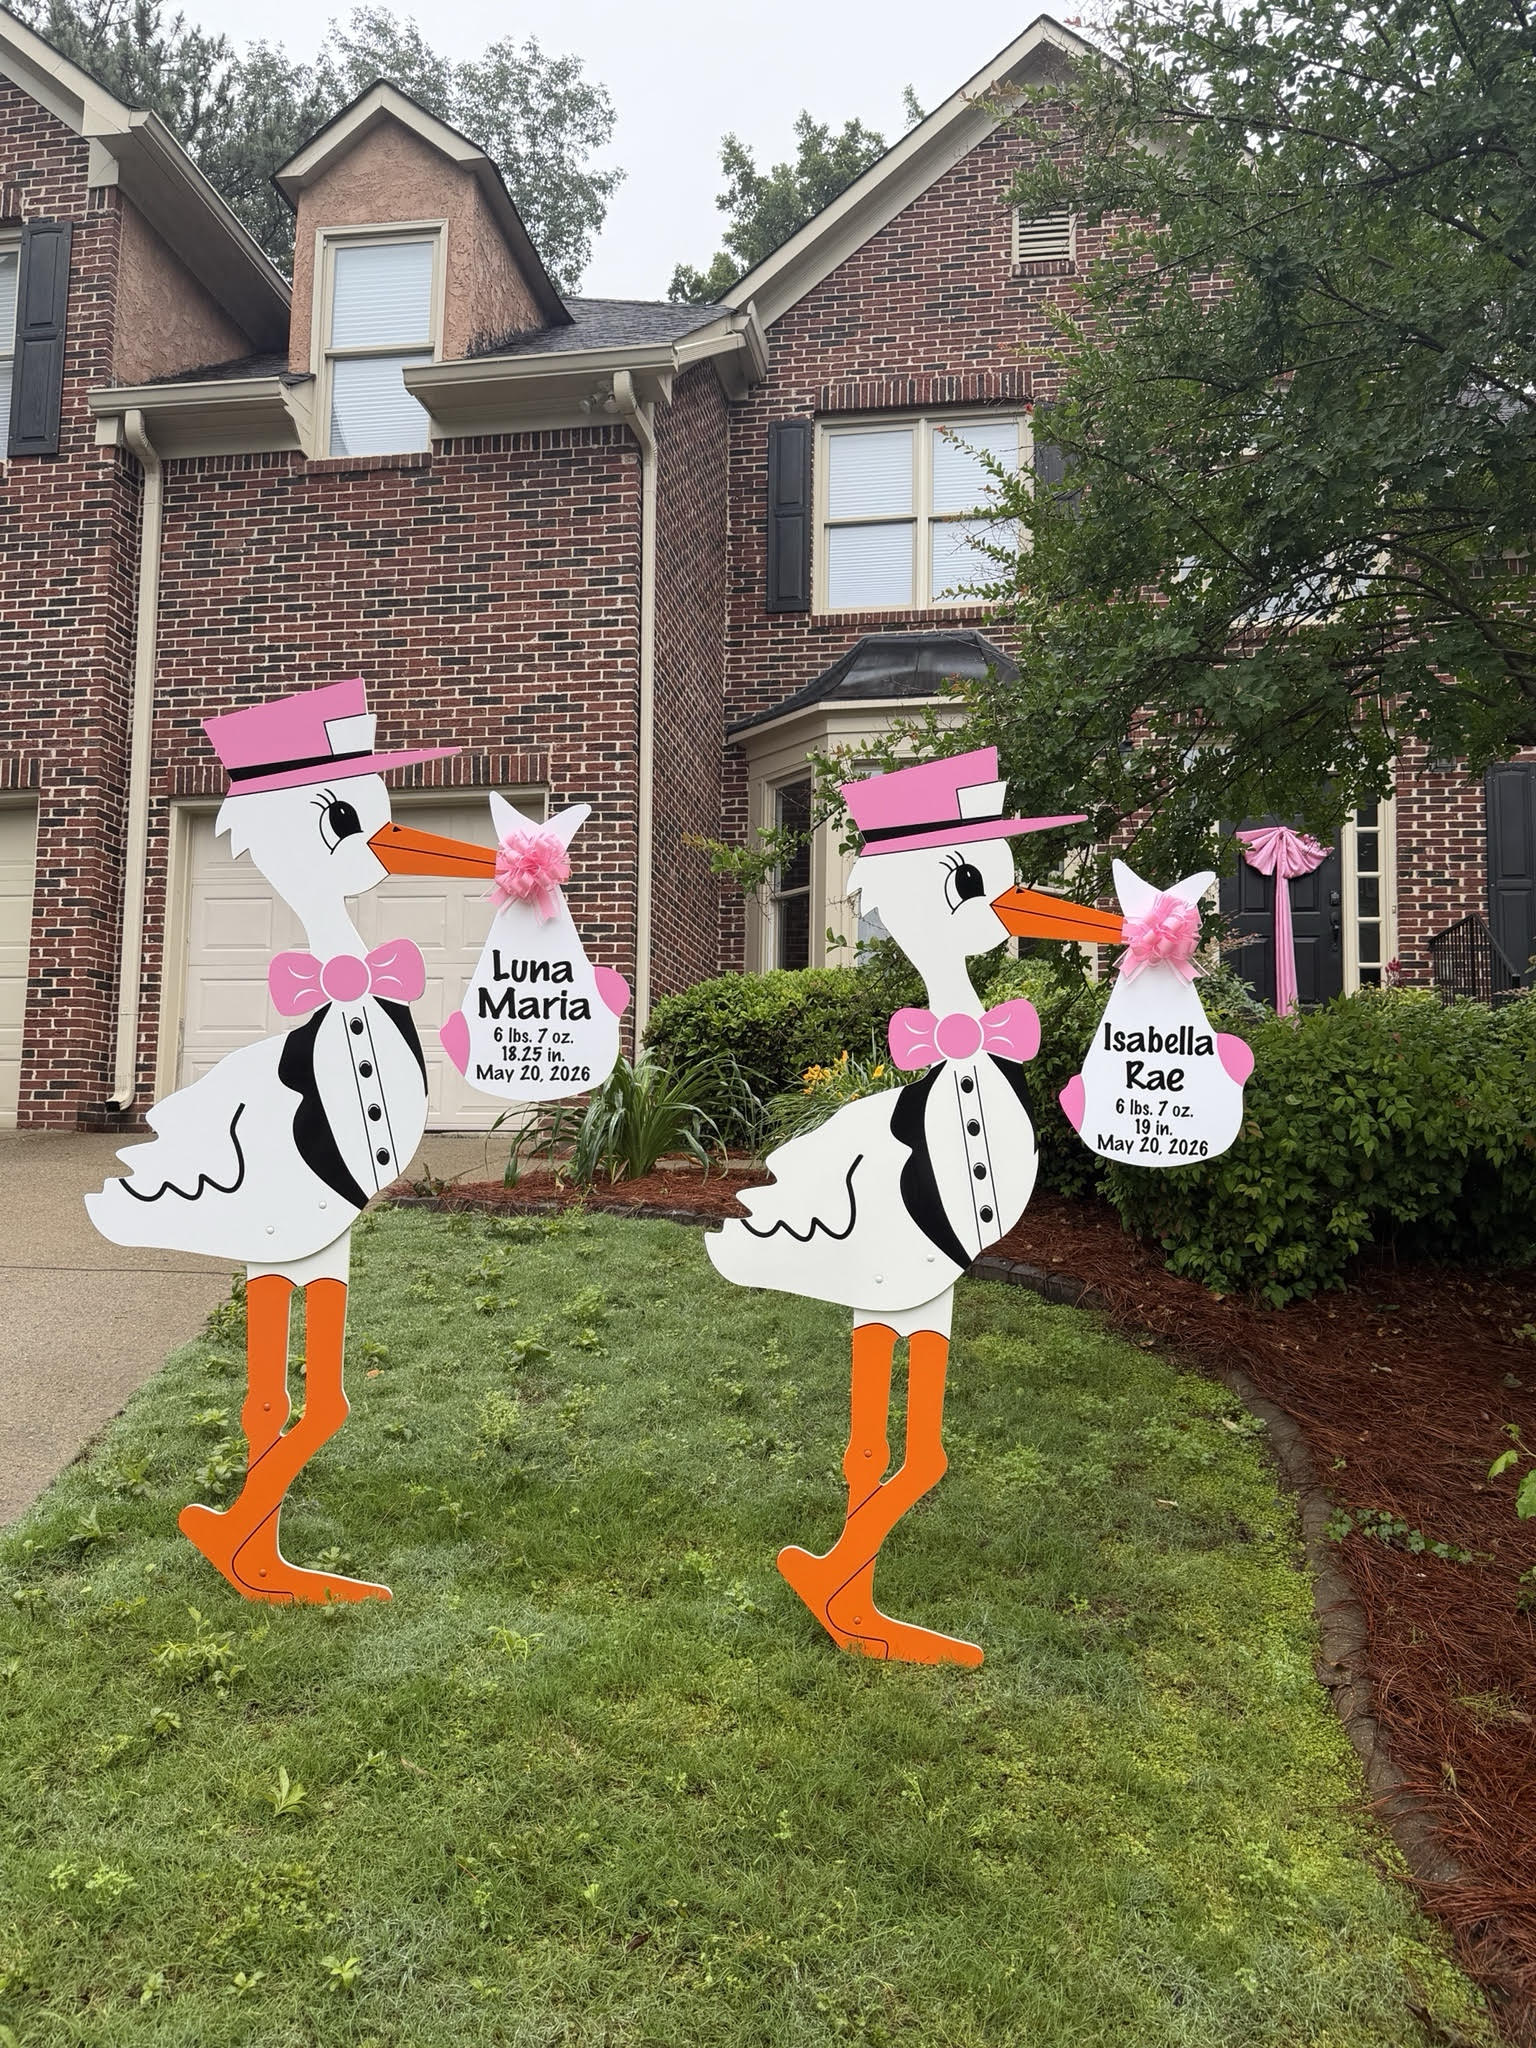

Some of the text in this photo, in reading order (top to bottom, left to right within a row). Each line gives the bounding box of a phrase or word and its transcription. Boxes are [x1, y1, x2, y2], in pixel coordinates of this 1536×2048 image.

[493, 950, 574, 983] Luna
[478, 987, 591, 1021] Maria
[494, 1027, 573, 1044] 6 lbs. 7 oz.
[1104, 1022, 1215, 1056] Isabella
[502, 1046, 564, 1062] 18.25 in.
[477, 1064, 590, 1083] May 20, 2026
[1126, 1061, 1184, 1092] Rae
[1116, 1098, 1193, 1117] 6 lbs. 7 oz.
[1136, 1119, 1172, 1136] 19 in.
[1096, 1134, 1208, 1156] May 20, 2026
